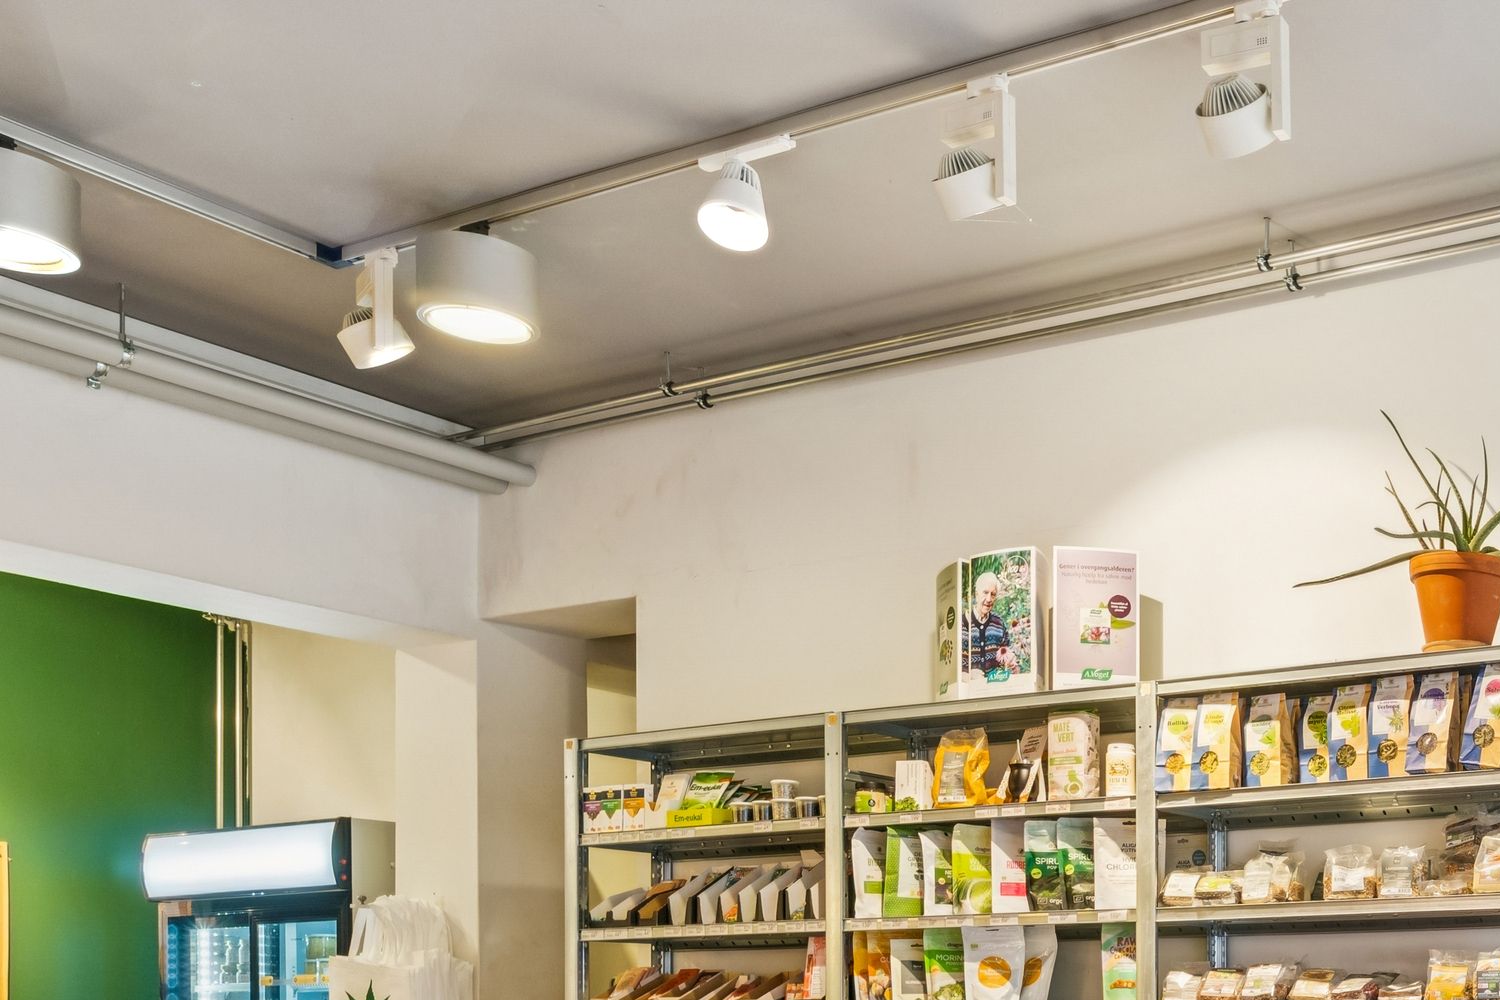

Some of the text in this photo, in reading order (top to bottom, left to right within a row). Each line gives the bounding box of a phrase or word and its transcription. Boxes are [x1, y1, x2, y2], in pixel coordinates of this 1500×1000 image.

[1084, 670, 1110, 680] A.Vogel
[1058, 732, 1074, 743] VERT
[689, 782, 722, 792] Em-eukal
[674, 814, 703, 822] Em-eukal
